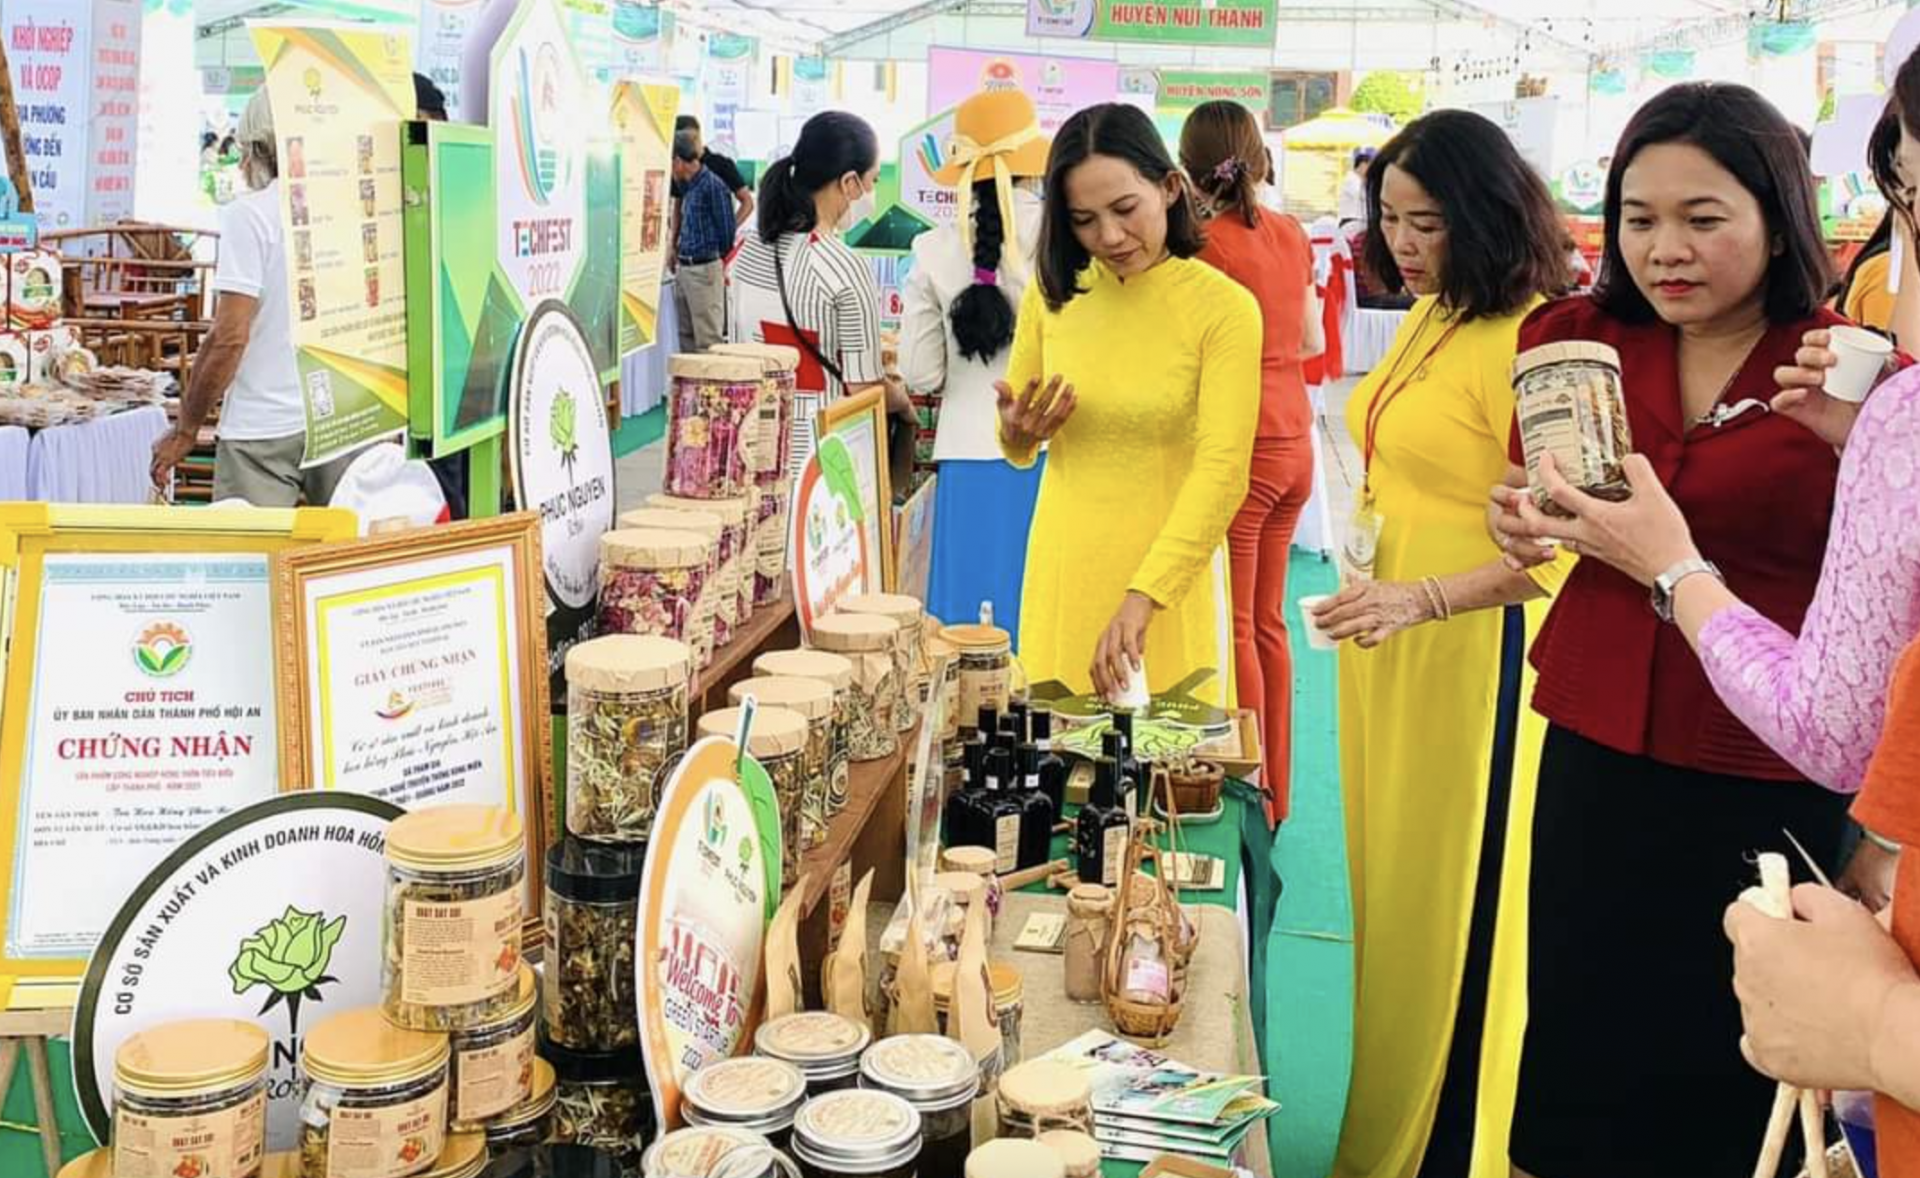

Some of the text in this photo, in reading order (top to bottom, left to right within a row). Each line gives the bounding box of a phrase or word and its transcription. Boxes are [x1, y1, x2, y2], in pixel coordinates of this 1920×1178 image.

[513, 219, 573, 257] TECHFEST
[528, 261, 561, 298] 2022
[72, 708, 94, 721] BAN
[246, 706, 261, 718] AN
[58, 730, 254, 761] CHỨNG NHẬN
[157, 881, 197, 925] XUẤT
[220, 839, 261, 870] KINH
[264, 825, 320, 850] DOANH
[323, 825, 355, 843] HOA
[667, 951, 724, 1016] Welcome
